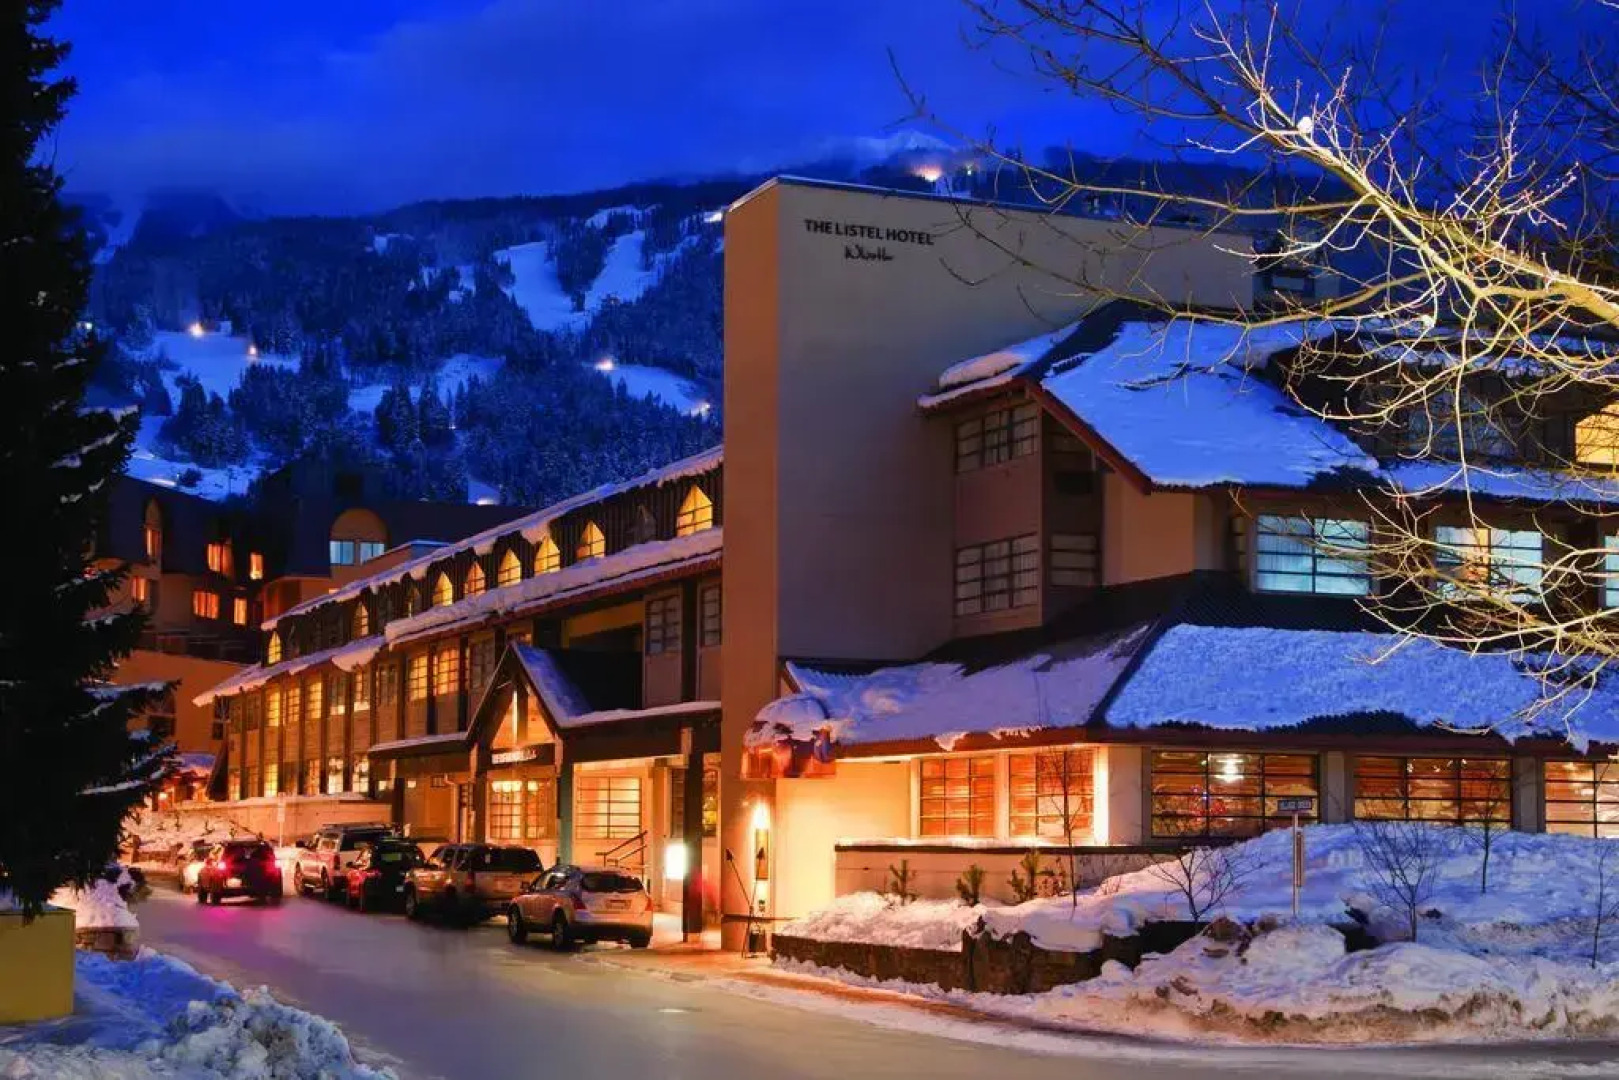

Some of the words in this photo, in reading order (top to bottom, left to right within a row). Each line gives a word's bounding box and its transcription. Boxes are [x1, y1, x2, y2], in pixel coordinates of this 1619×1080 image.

[804, 219, 832, 235] THE
[835, 222, 883, 240] LISTEL
[887, 227, 934, 246] HOTEL
